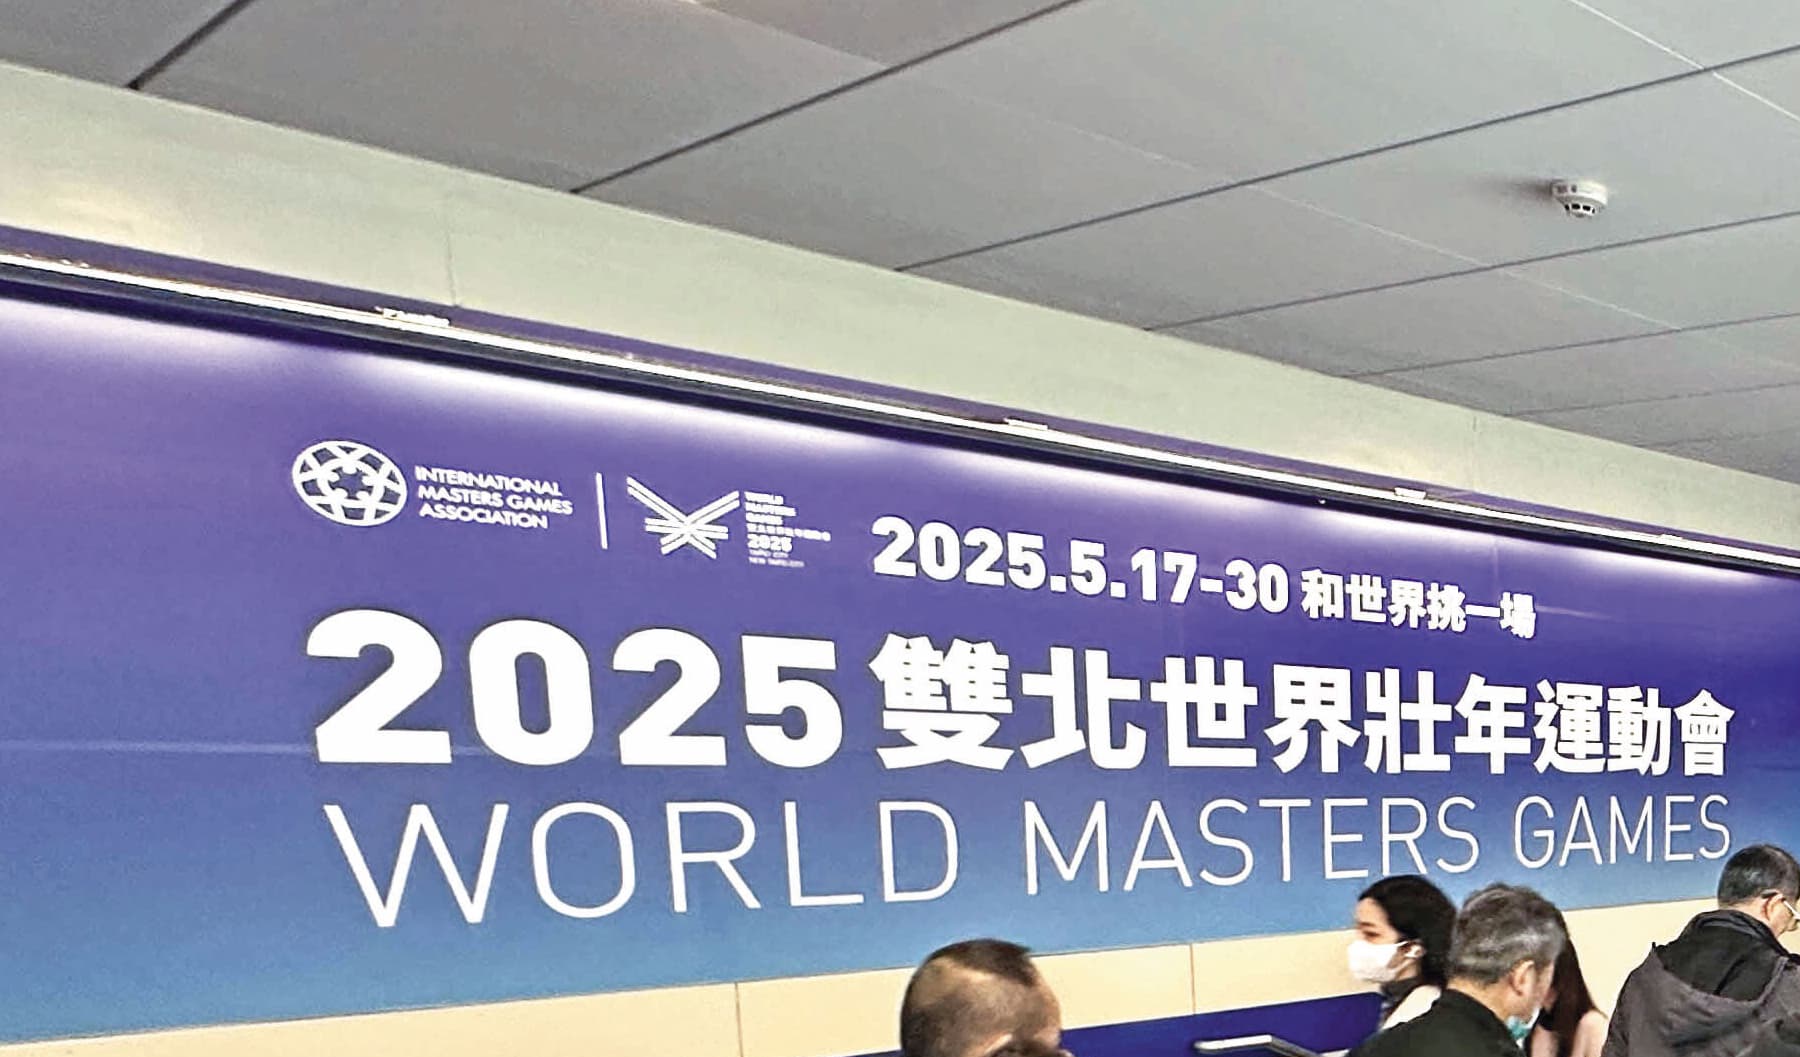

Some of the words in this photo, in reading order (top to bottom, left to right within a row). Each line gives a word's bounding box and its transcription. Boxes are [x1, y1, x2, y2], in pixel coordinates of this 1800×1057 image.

[415, 466, 562, 496] INTERNATIONAL
[418, 485, 503, 507] MASTERS
[507, 495, 573, 515] GAMES
[419, 504, 548, 528] ASSOCIATION
[872, 515, 1288, 614] 2025.5.17-30
[1301, 567, 1537, 640] 和世界挑一場
[306, 609, 844, 770] 2025
[869, 632, 1734, 777] 雙北世界壯年運動會
[324, 800, 959, 928] WORLD
[1025, 796, 1478, 896] MASTERS
[1515, 794, 1731, 869] GAMES
